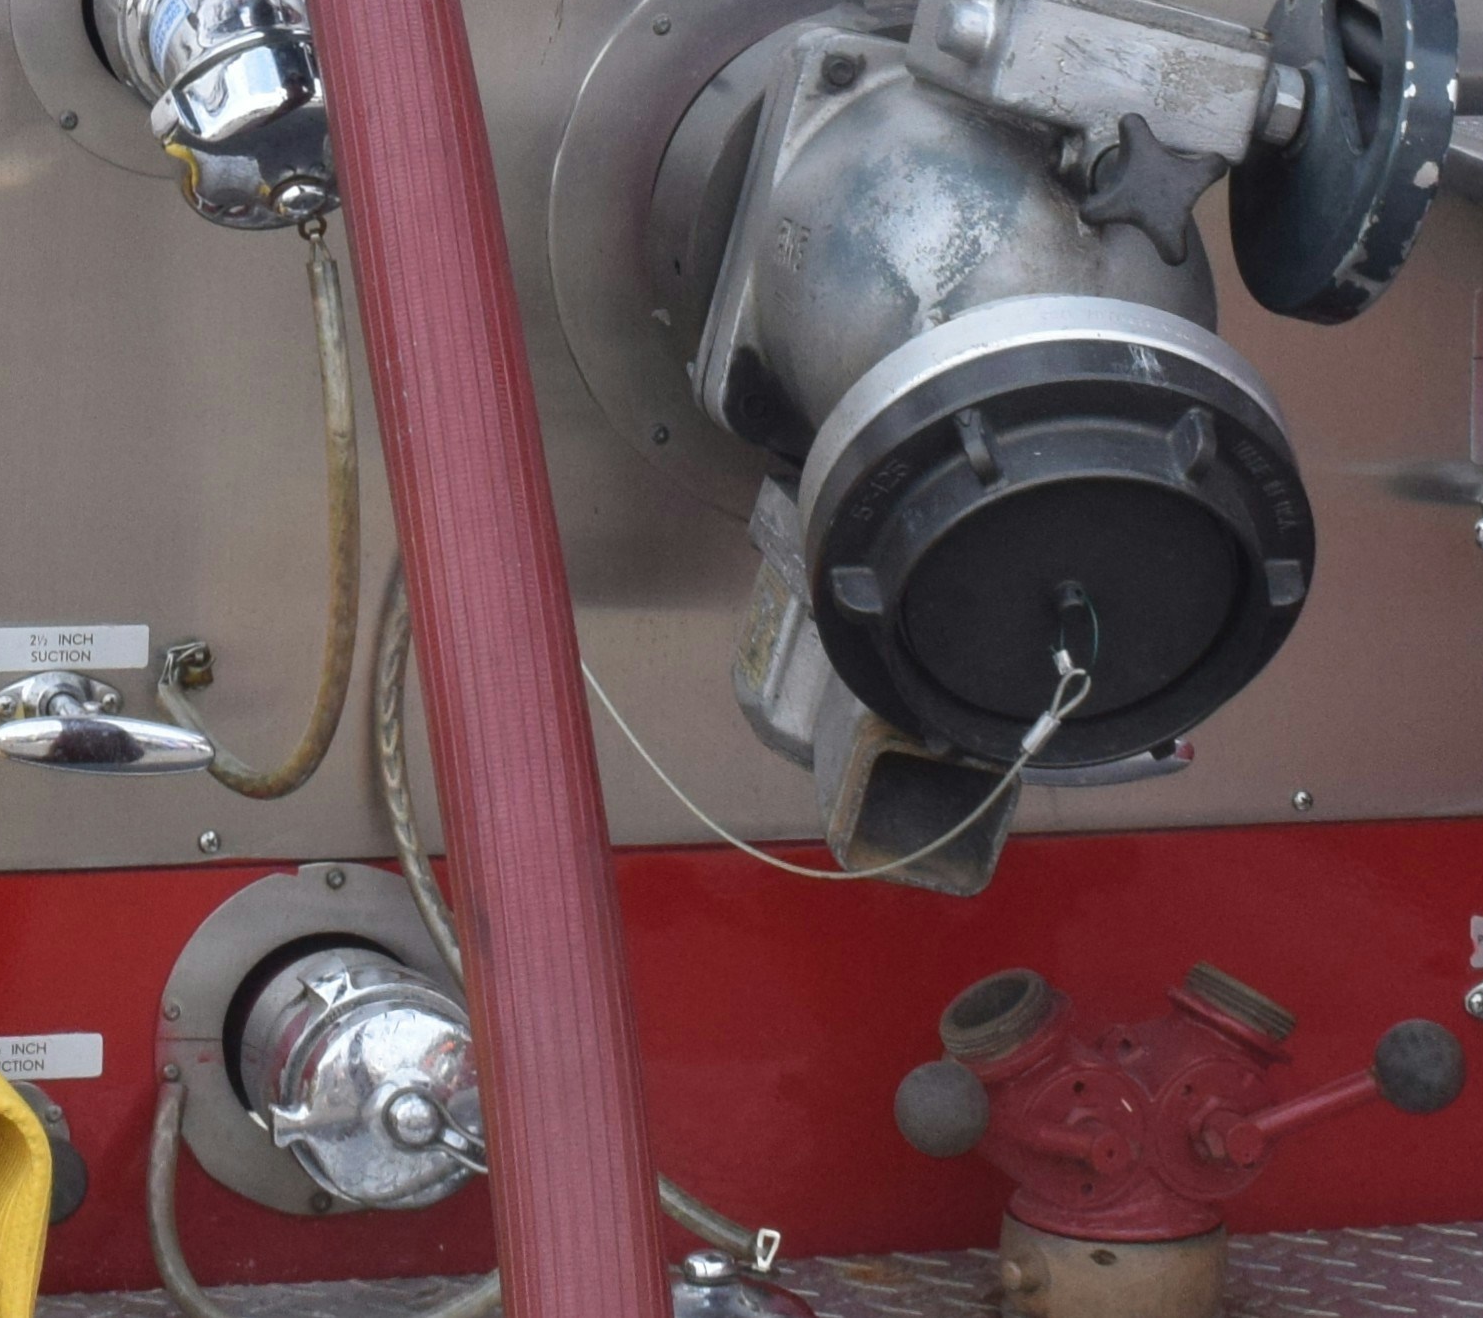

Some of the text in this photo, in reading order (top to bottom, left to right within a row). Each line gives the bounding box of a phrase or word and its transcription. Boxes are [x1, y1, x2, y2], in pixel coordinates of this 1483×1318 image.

[58, 633, 94, 646] INCH
[30, 650, 91, 663] SUCTION
[11, 1043, 47, 1056] INCH
